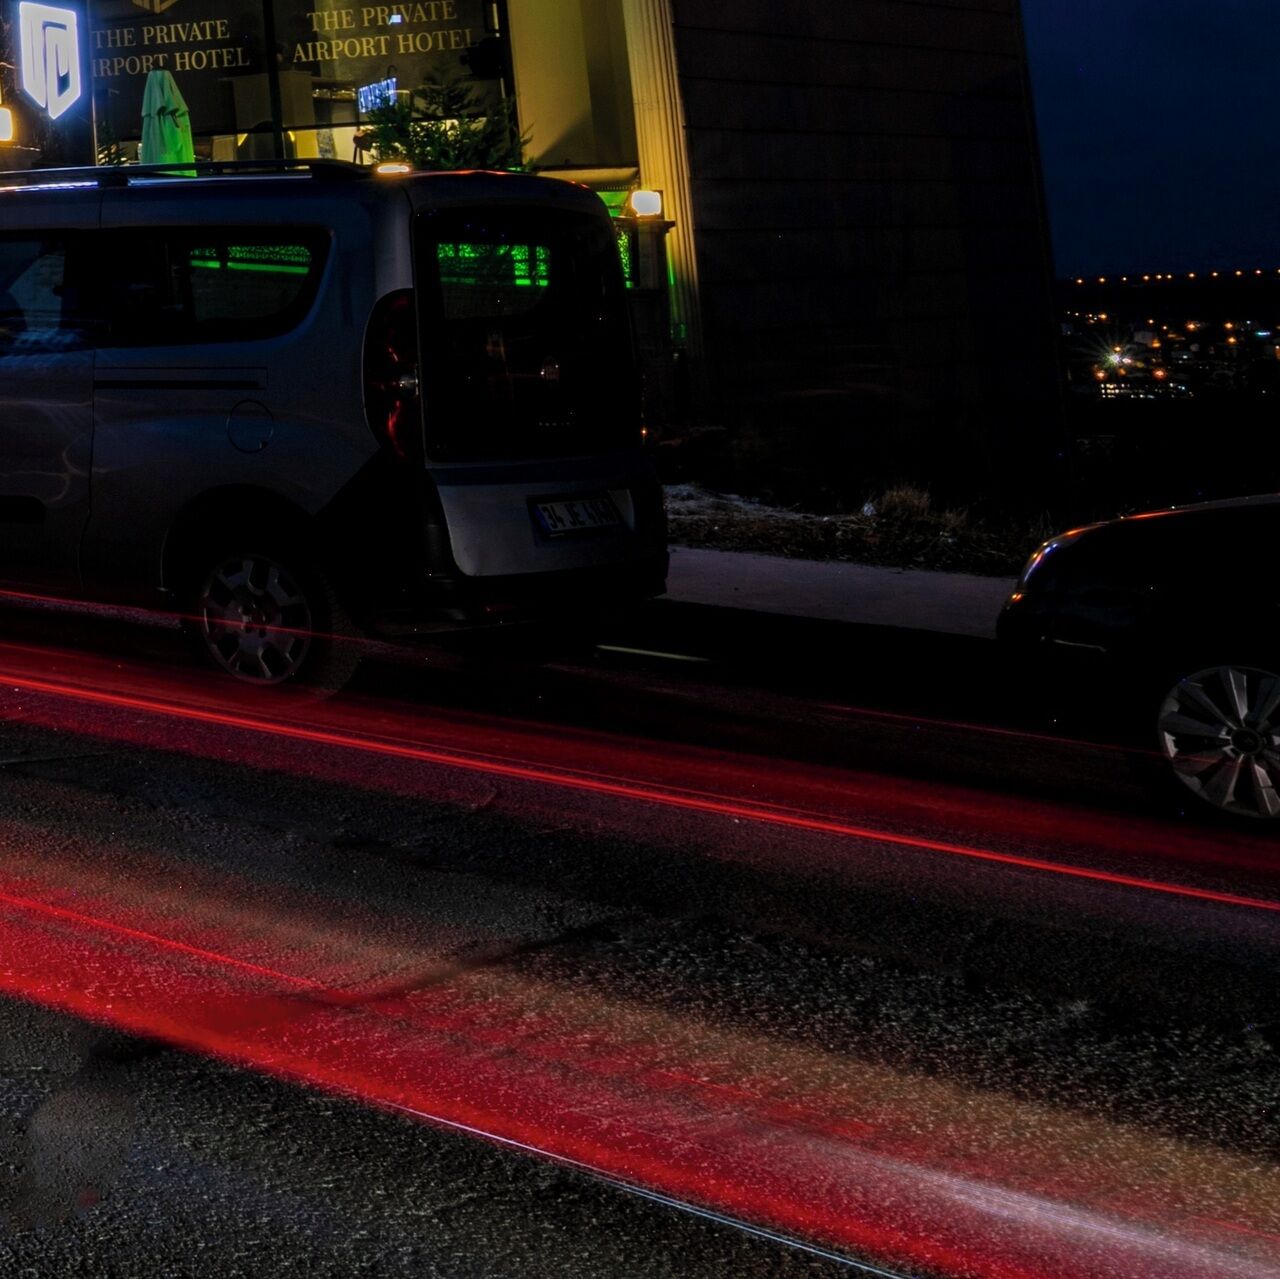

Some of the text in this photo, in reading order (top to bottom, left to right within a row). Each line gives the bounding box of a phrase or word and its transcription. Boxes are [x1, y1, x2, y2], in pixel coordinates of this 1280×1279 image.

[306, 0, 457, 32] THE PRIVATE
[92, 19, 230, 49] THE PRIVATE
[293, 29, 479, 63] AIRPORT HOTEL
[92, 47, 250, 78] IRPORT HOTEL
